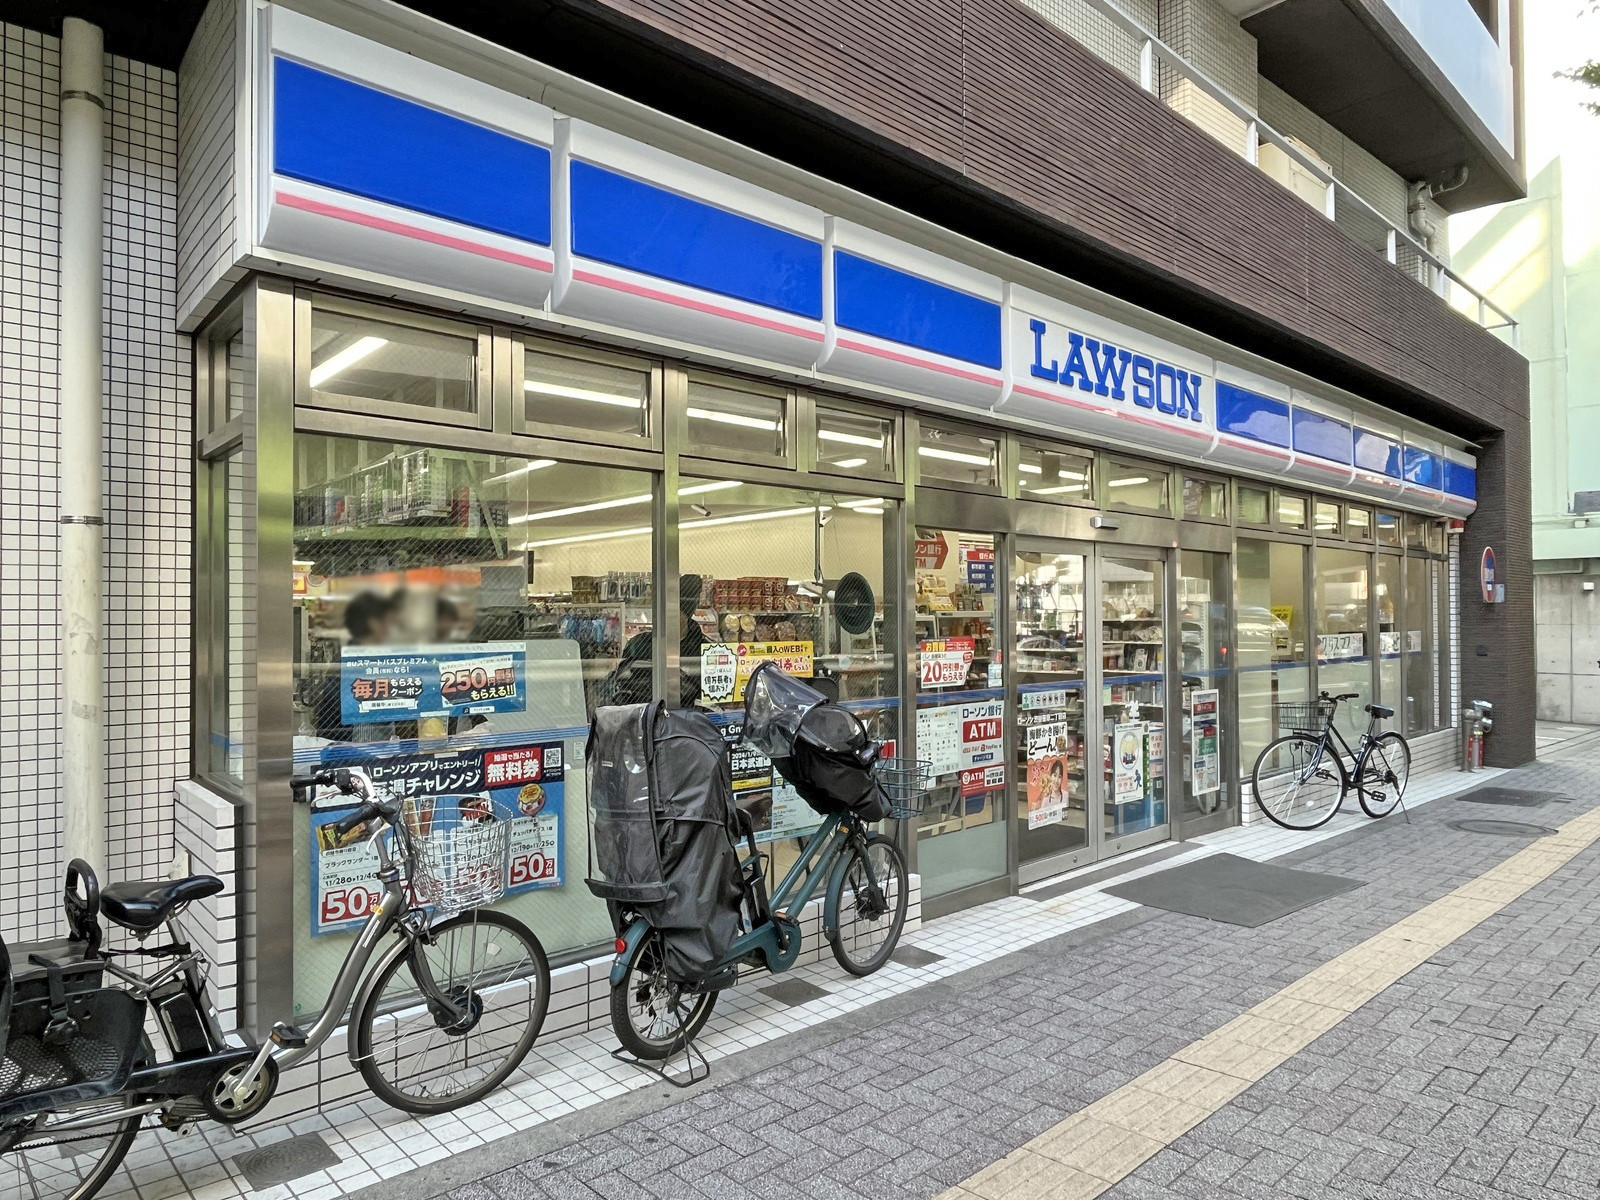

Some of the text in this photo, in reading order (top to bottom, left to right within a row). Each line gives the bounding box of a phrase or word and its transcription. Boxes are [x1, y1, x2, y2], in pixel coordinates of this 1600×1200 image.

[1030, 318, 1203, 422] LAWSON
[922, 660, 942, 683] 20
[352, 677, 422, 699] 毎月 もらえる
[390, 688, 423, 697] クーポン
[470, 685, 514, 701] もらえる!!
[962, 704, 1002, 719] ローソン銀行
[969, 721, 996, 740] ATM
[373, 758, 479, 777] ローソンアプリでエントリー!
[487, 759, 540, 783] 無料券
[970, 771, 984, 782] ATM
[512, 852, 544, 882] 50
[325, 886, 368, 920] 50
